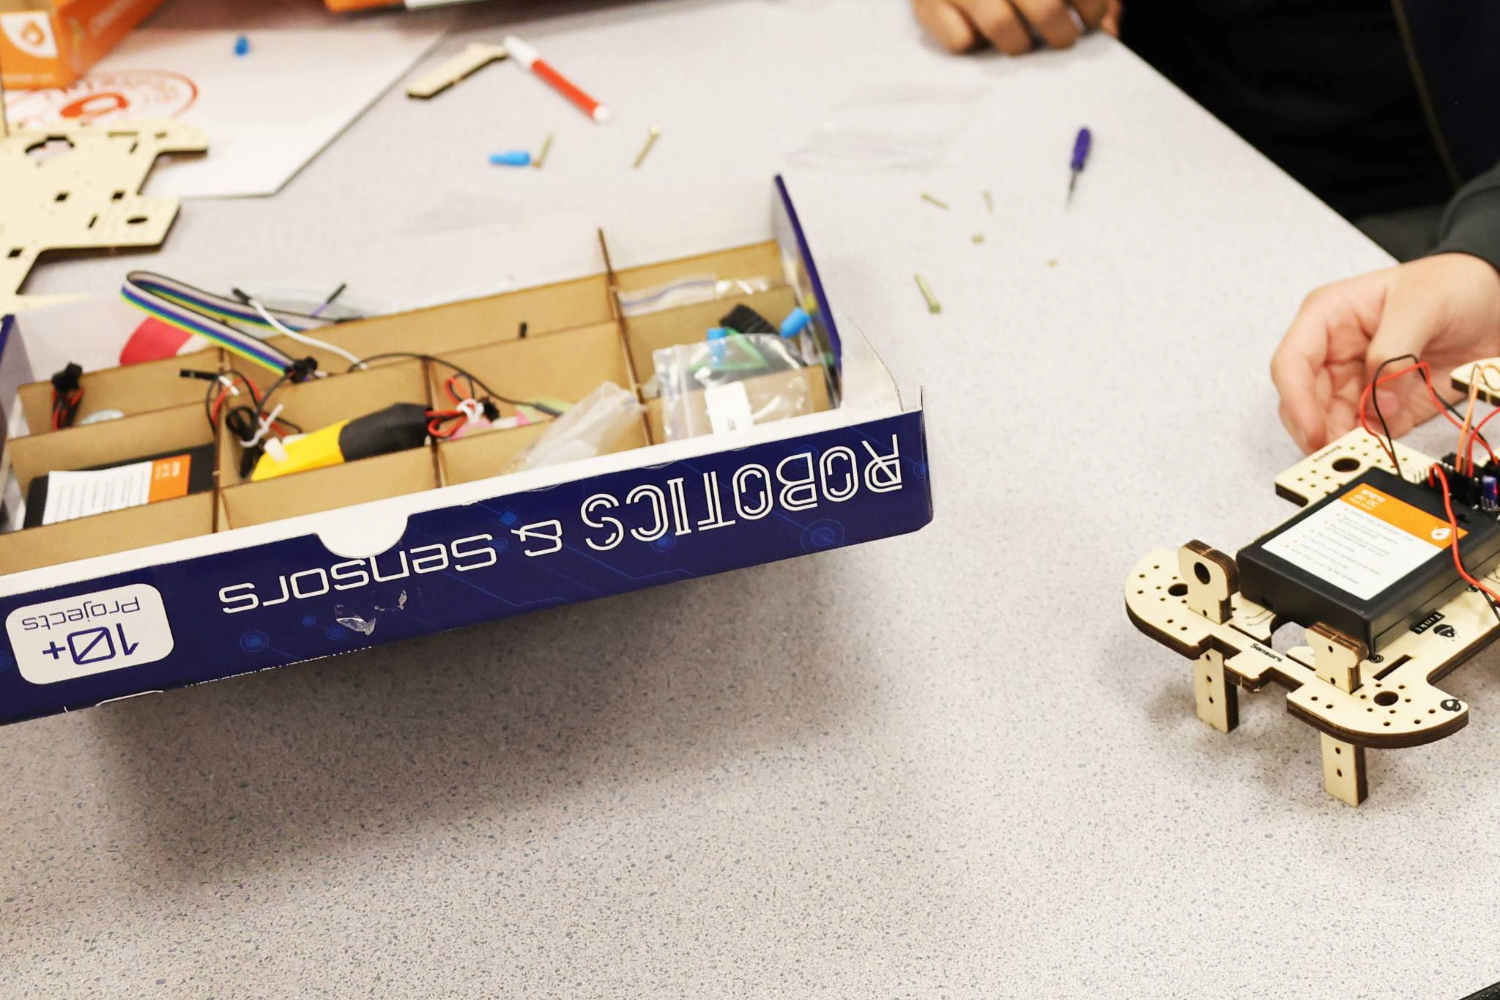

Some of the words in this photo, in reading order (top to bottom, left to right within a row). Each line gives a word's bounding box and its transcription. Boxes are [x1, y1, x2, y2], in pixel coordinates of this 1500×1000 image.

[580, 433, 903, 551] ROBOTICS
[511, 519, 563, 558] &
[218, 533, 498, 615] Sensors
[21, 595, 140, 631] Projects
[41, 622, 140, 666] 10+
[1250, 642, 1283, 663] Sensors
